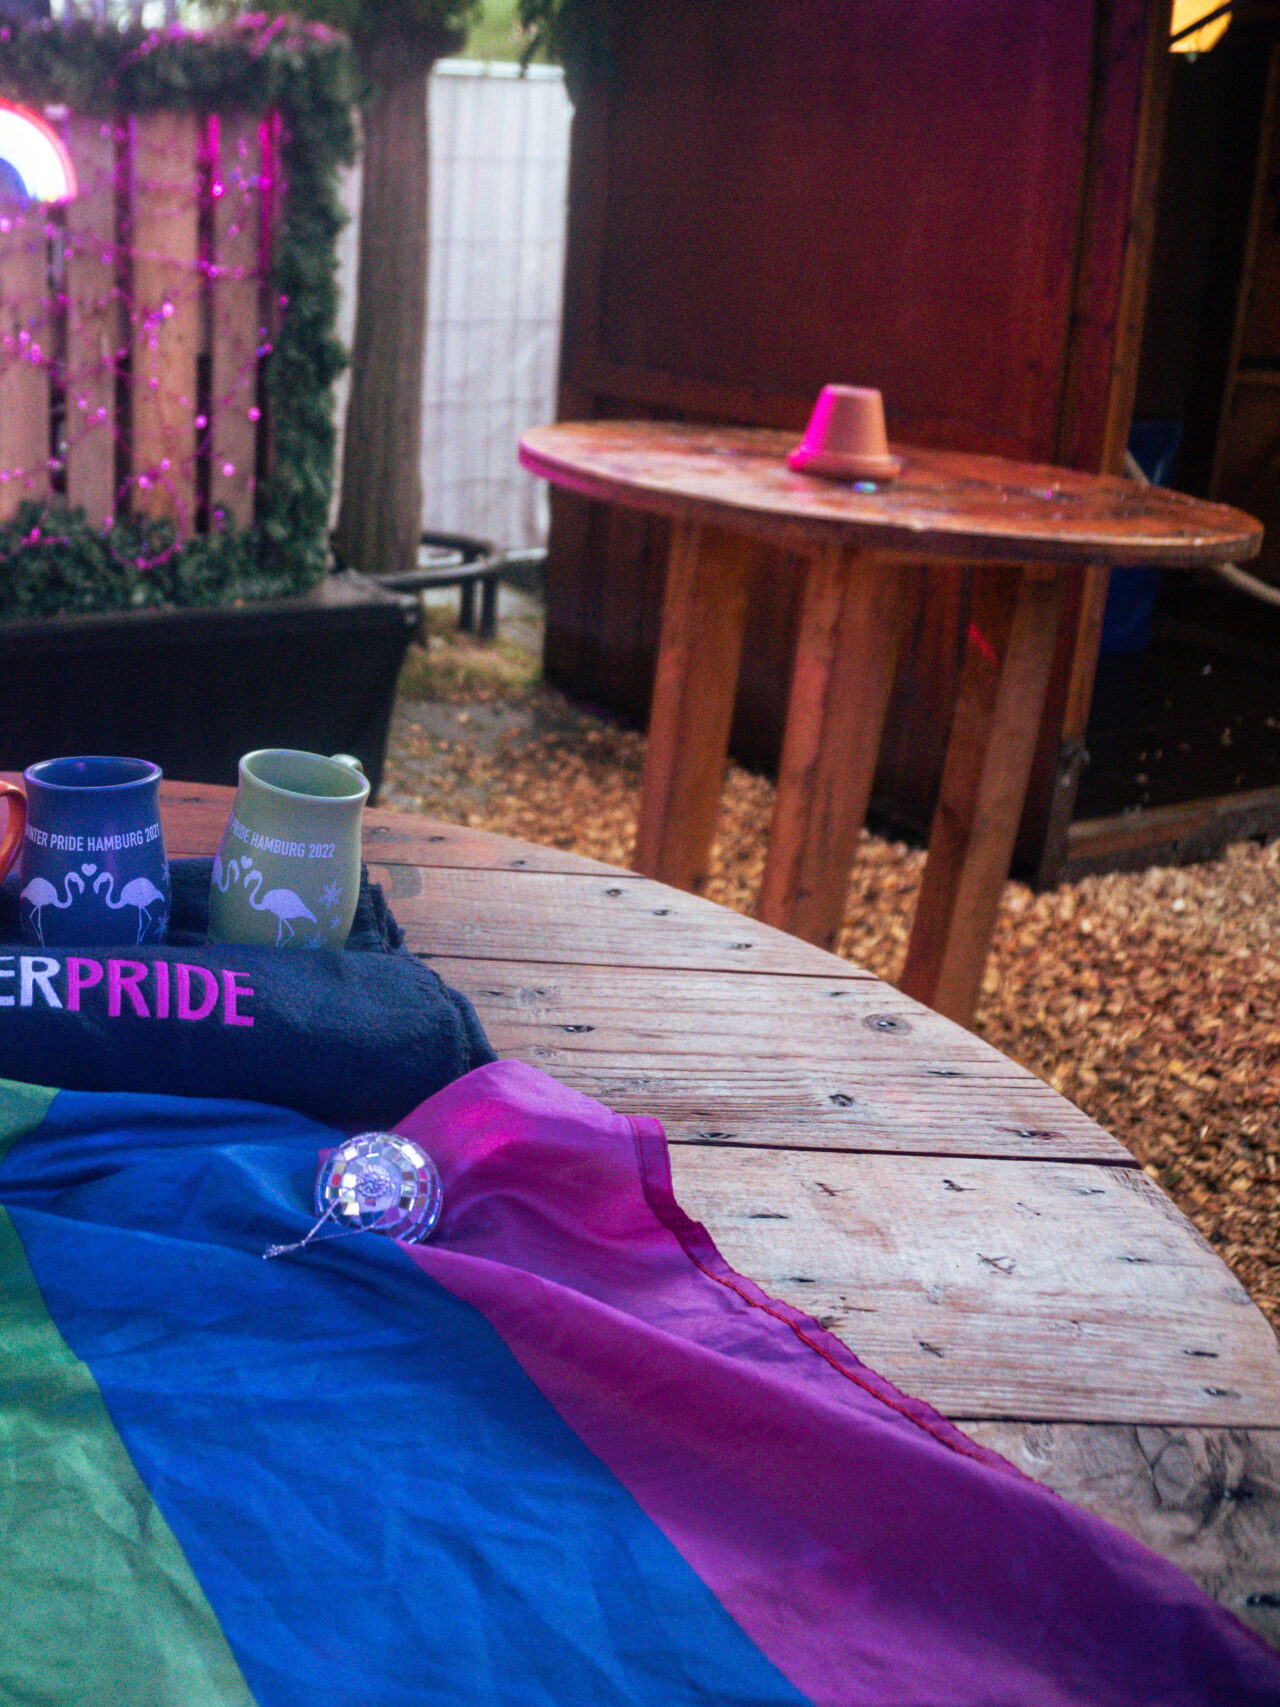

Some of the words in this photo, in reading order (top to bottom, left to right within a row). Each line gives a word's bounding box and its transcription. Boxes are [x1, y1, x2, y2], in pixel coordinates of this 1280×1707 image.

[50, 834, 84, 851] PRIDE
[87, 830, 144, 852] HAMBURG
[144, 822, 161, 843] 2021
[250, 831, 306, 857] HAMBURG
[308, 843, 336, 859] 2022
